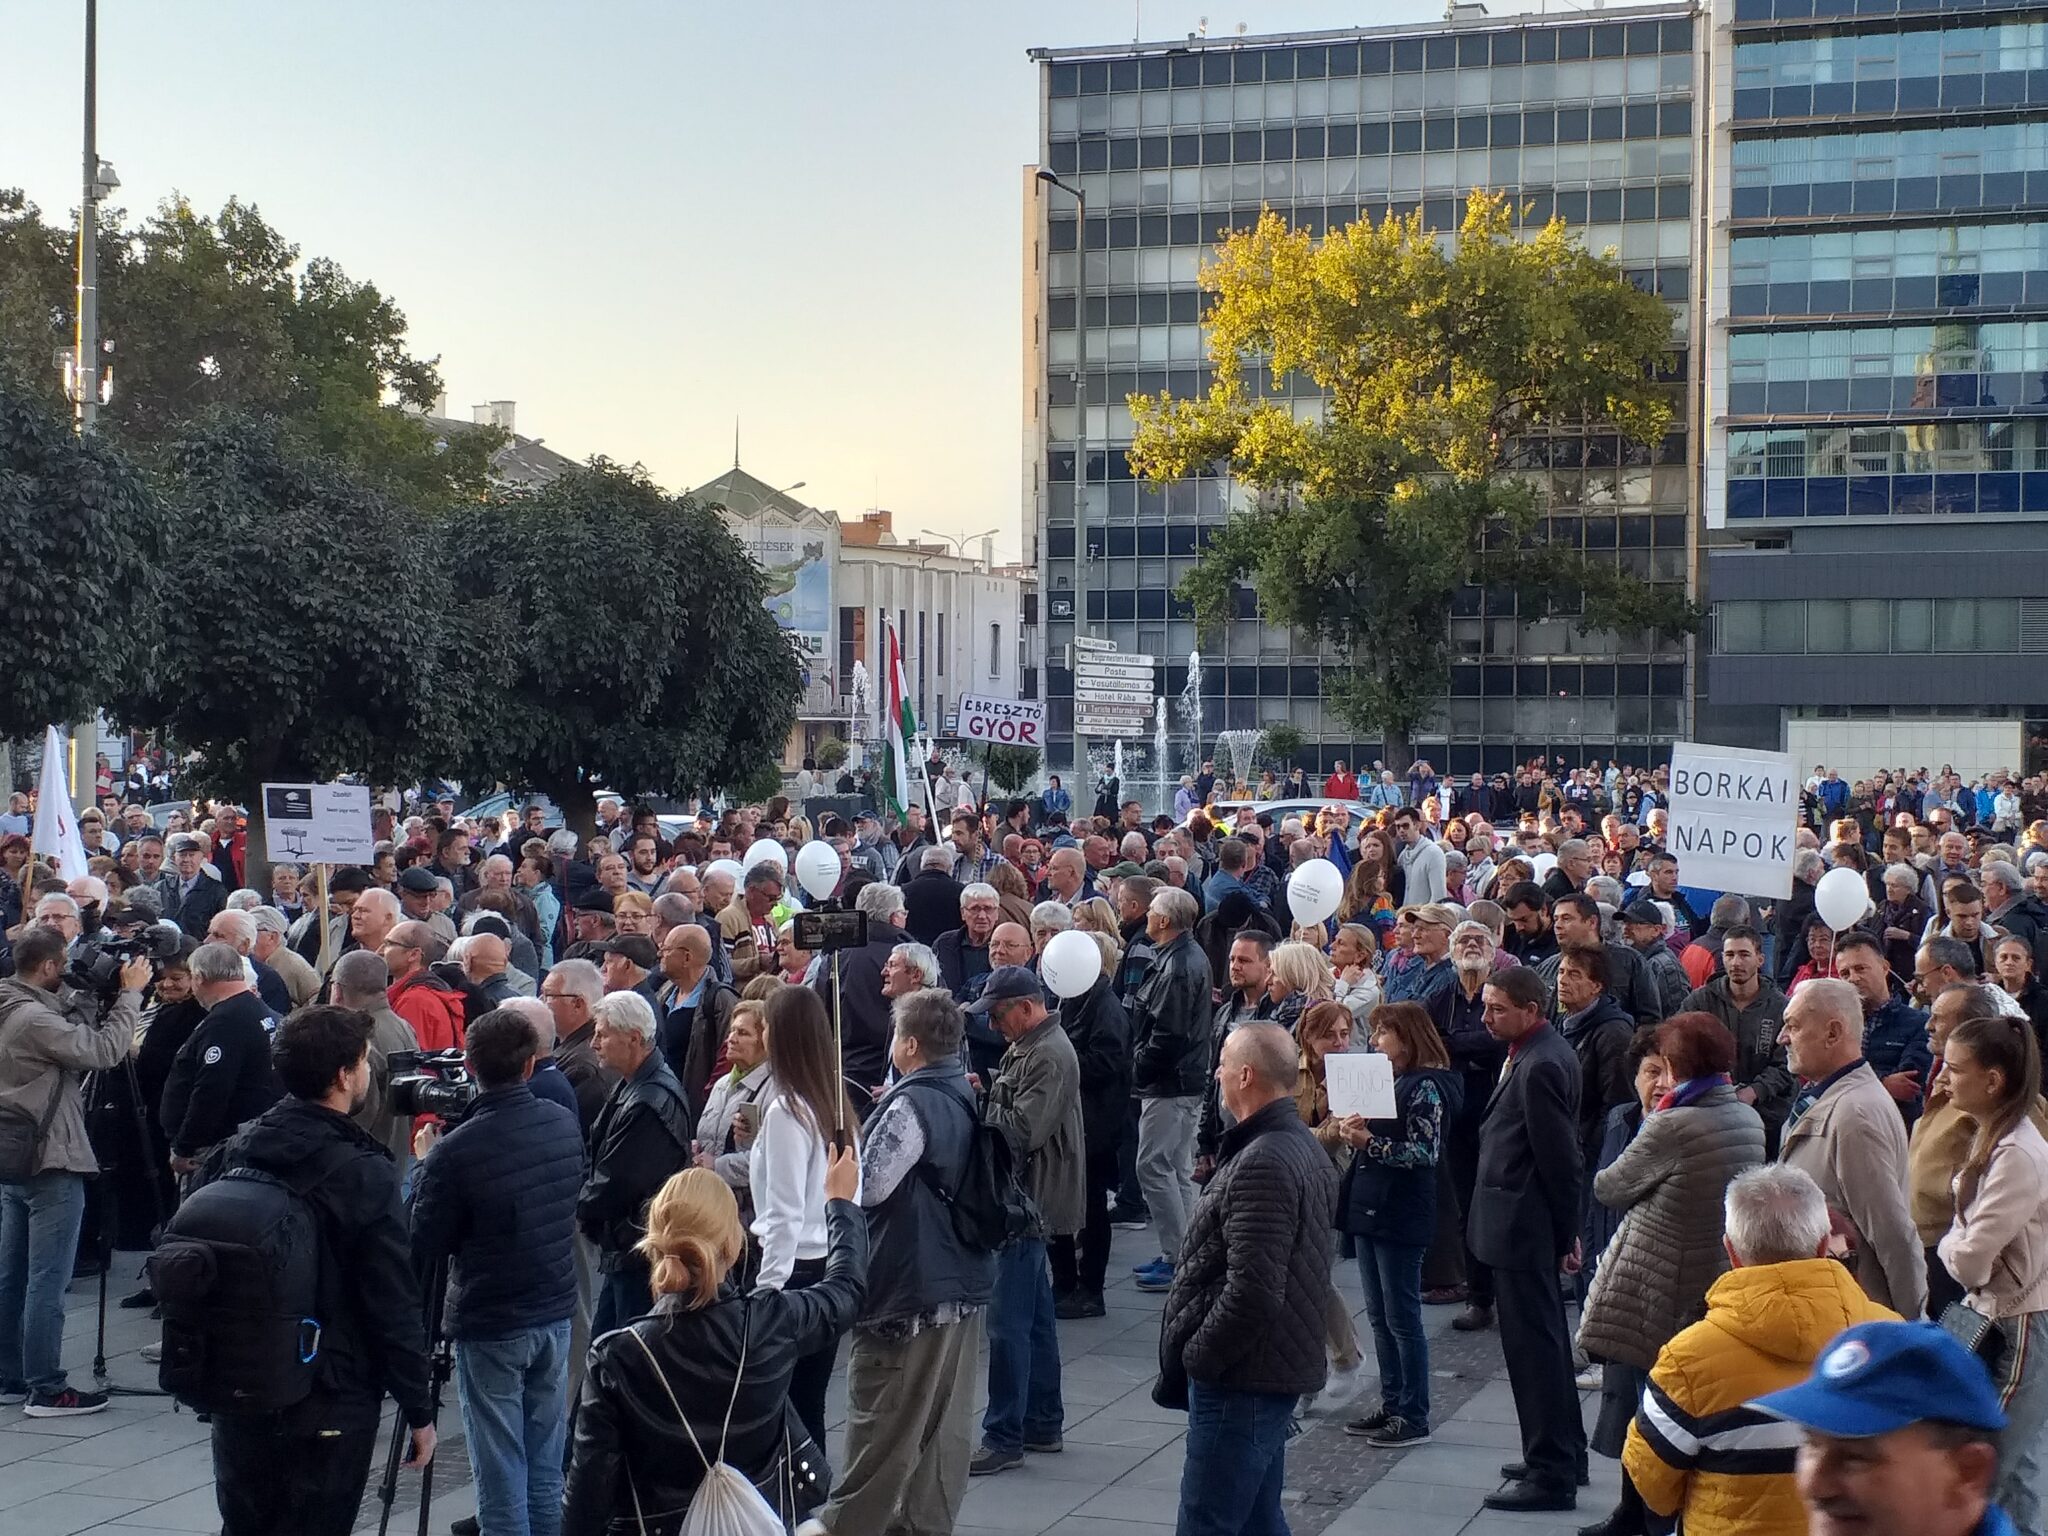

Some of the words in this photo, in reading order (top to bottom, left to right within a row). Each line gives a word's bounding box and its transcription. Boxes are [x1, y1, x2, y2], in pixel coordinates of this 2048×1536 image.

[1104, 667, 1127, 676] Posta
[1090, 679, 1140, 689] Vasútállomás
[1094, 692, 1115, 700] Hotel
[1117, 693, 1137, 702] Rába
[968, 715, 1039, 745] GYŐR
[1674, 769, 1788, 804] BORKAI
[1674, 825, 1788, 862] NAPOK
